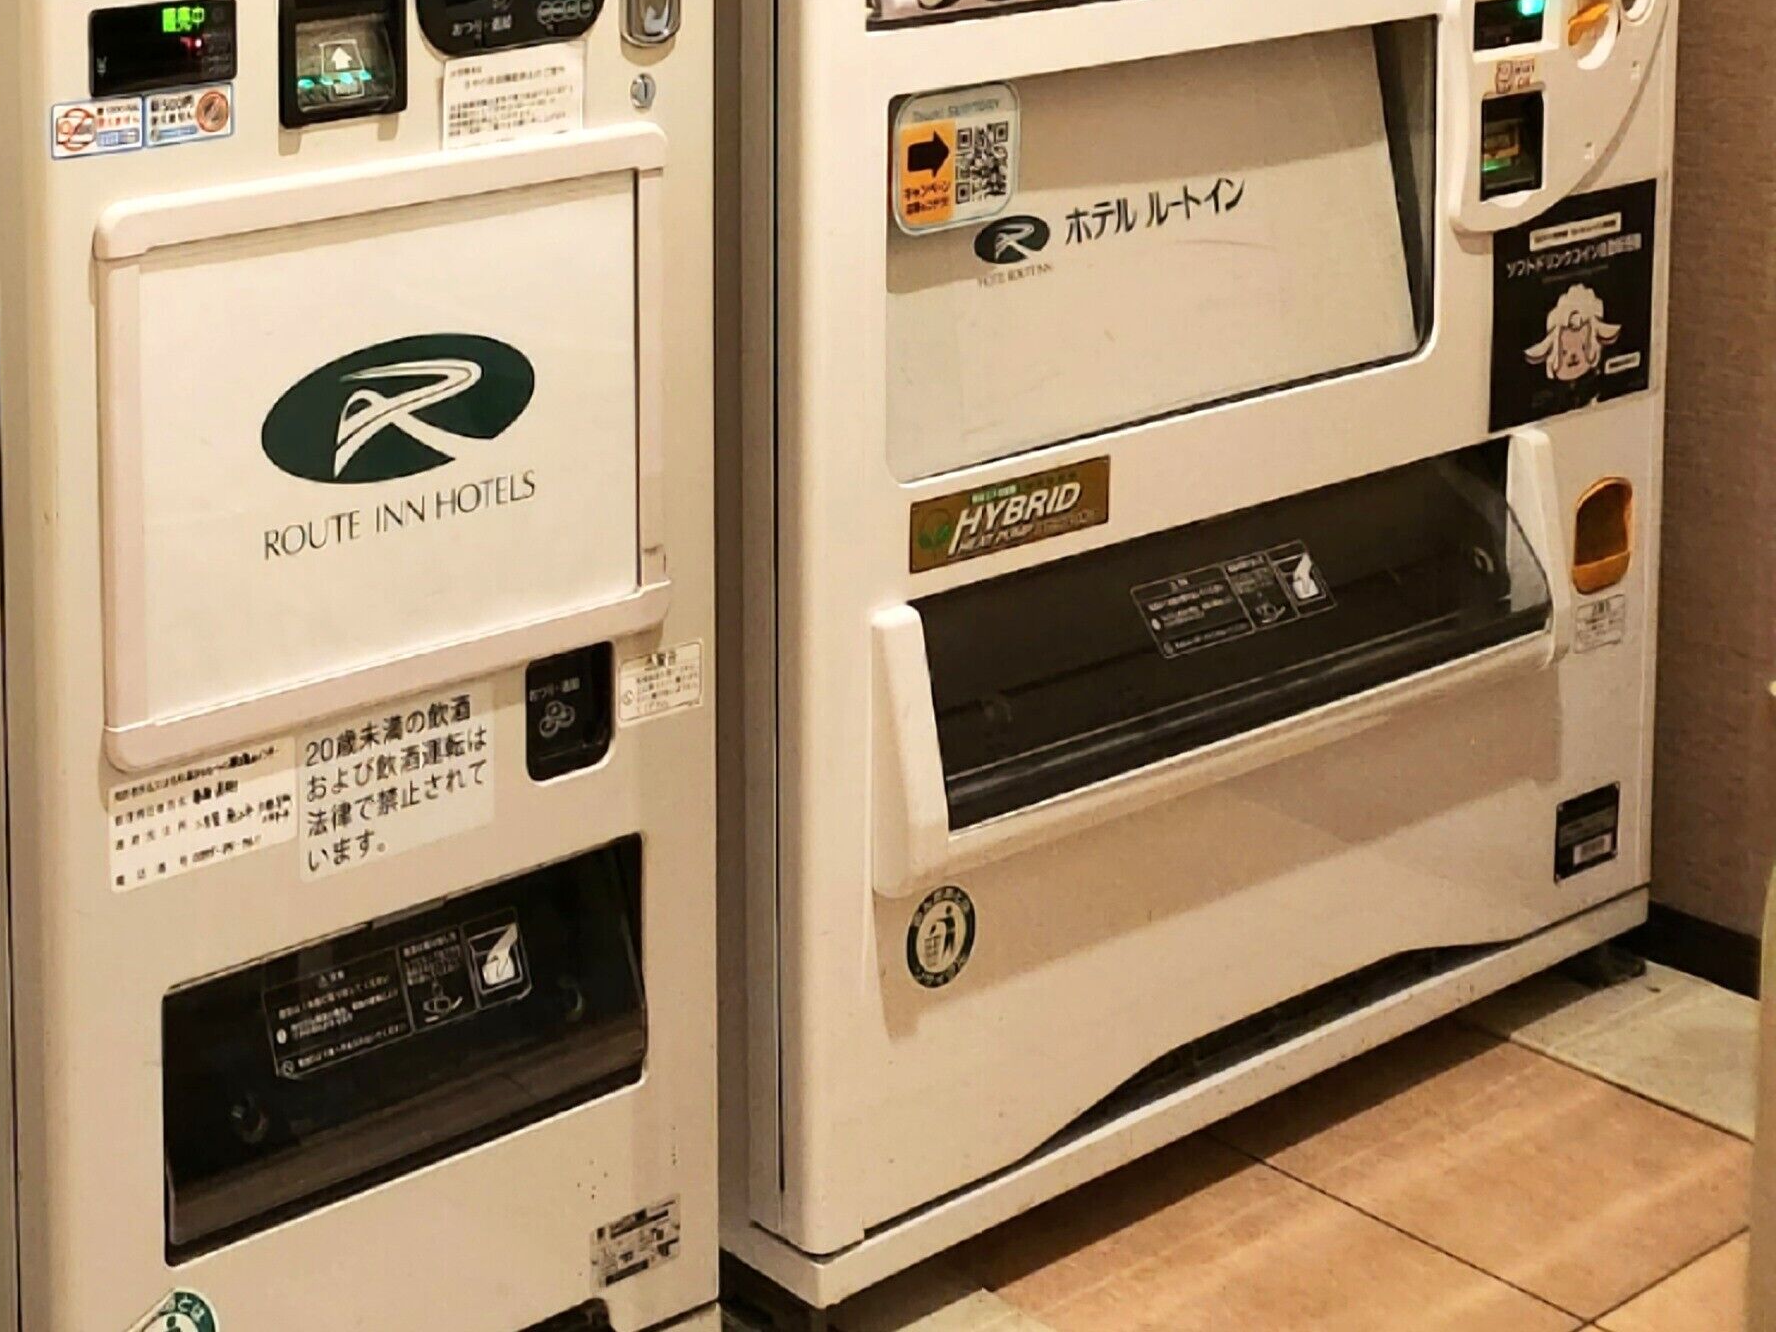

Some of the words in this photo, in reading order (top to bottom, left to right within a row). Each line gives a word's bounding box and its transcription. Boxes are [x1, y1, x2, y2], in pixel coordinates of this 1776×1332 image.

[1066, 197, 1137, 245] ホテル
[1149, 178, 1245, 228] ルートイン
[263, 510, 362, 561] ROUTE
[376, 493, 426, 535] INN
[436, 469, 536, 522] HOTELS
[948, 481, 1081, 556] HYBRID
[305, 693, 472, 767] 20歳未満の飲酒
[306, 725, 488, 801] および飲酒運転は
[307, 761, 487, 836] 法律で禁止されて
[308, 833, 387, 873] います。
